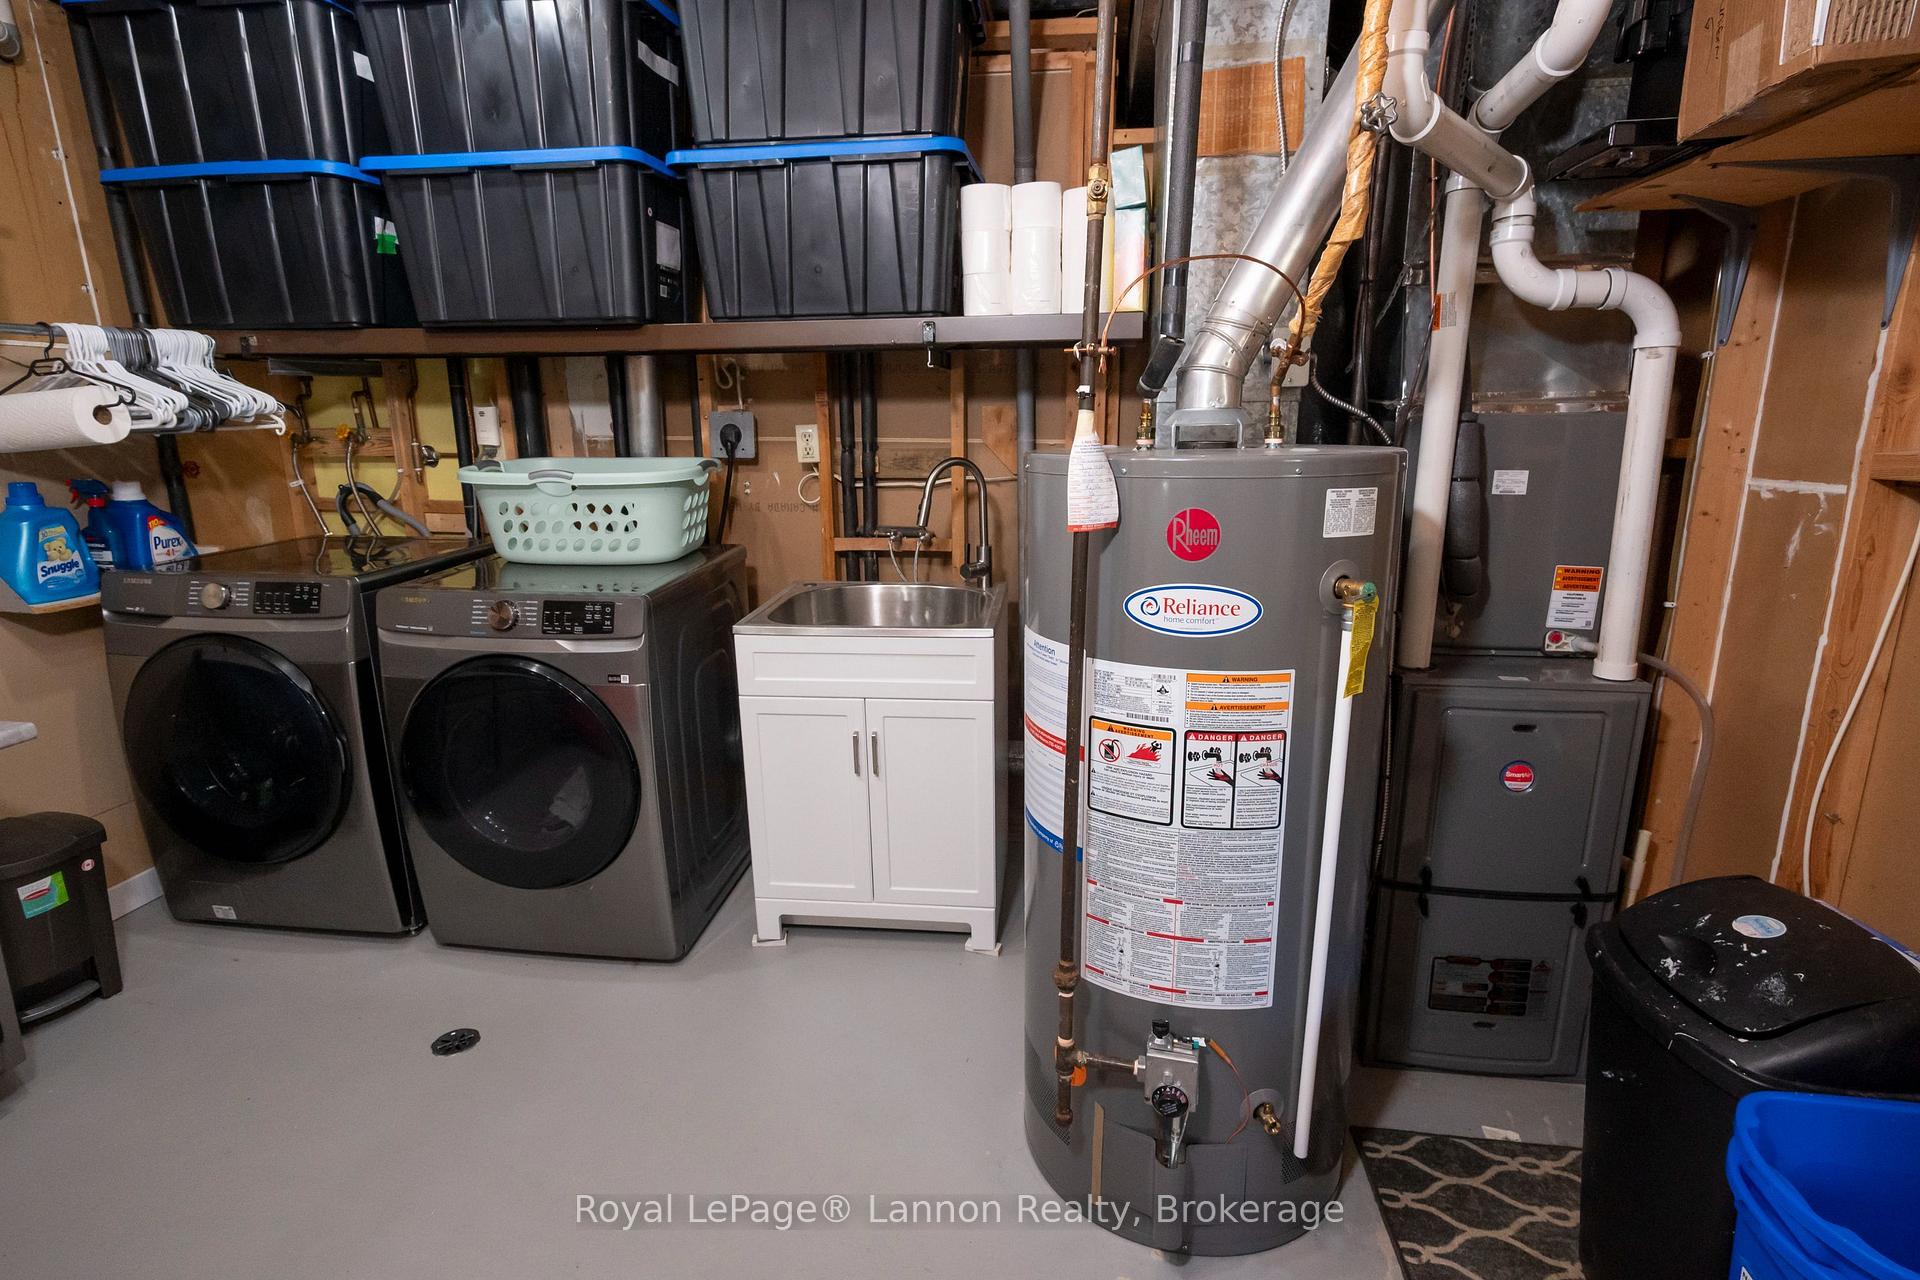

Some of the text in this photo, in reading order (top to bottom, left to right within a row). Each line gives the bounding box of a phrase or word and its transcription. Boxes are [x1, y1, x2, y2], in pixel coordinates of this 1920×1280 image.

[1172, 509, 1218, 553] Rheem
[153, 535, 182, 550] Purex
[39, 559, 80, 578] Snuggle
[1163, 597, 1241, 617] Reliance
[1163, 616, 1215, 625] home comfort
[1033, 639, 1056, 657] Attention
[1198, 733, 1233, 741] DANGER
[1249, 733, 1283, 741] DANGER
